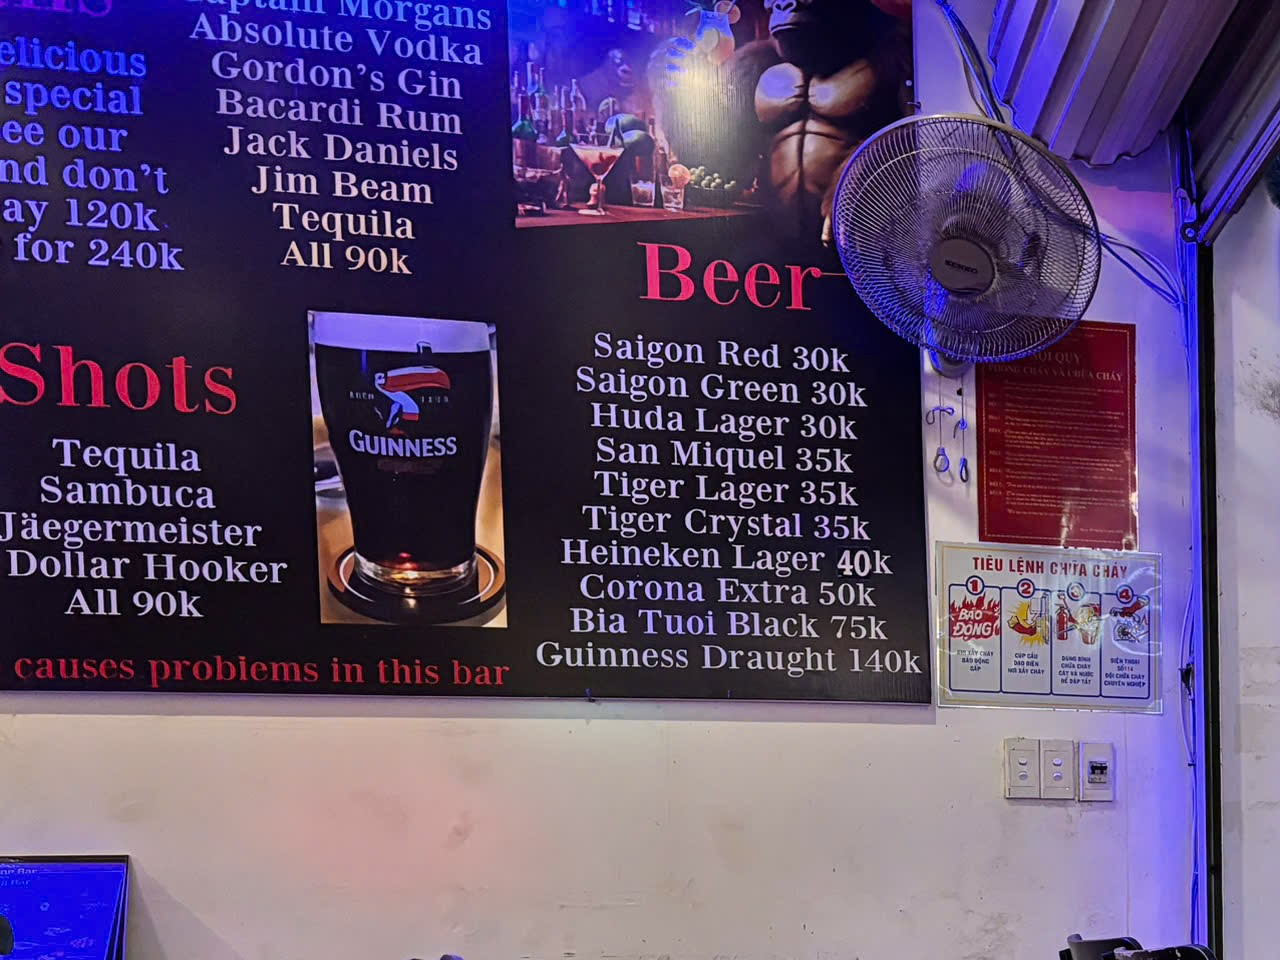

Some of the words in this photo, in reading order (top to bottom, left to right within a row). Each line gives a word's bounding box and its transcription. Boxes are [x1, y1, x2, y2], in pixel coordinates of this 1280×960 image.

[0, 36, 146, 78] elicious
[190, 13, 352, 52] Absolute
[365, 29, 483, 65] Vodka
[5, 81, 143, 116] special
[398, 69, 462, 99] Gin
[216, 88, 363, 125] Bacardi
[377, 103, 462, 134] Rum
[58, 127, 128, 151] our
[224, 126, 311, 158] Jack
[323, 134, 457, 170] Daniels
[252, 166, 319, 195] Jim
[332, 171, 433, 204] Beam
[66, 199, 159, 231] 120k
[273, 203, 415, 241] Tequila
[14, 233, 74, 263] for
[88, 239, 184, 270] 240k
[281, 241, 333, 268] All
[346, 246, 412, 274] 90k
[637, 242, 846, 310] Beer
[595, 333, 705, 368] Saigon
[719, 341, 781, 368] Red
[793, 346, 850, 372] 30k
[0, 343, 236, 414] Shots
[577, 367, 689, 402] Saigon
[701, 374, 800, 403] Green
[811, 382, 867, 407] 30k
[591, 403, 685, 431] Huda
[696, 408, 789, 442] Lager
[801, 414, 857, 439] 30k
[52, 439, 201, 476] Tequila
[349, 430, 457, 457] GUINNESS
[597, 437, 660, 464] San
[670, 441, 785, 475] Miquel
[796, 448, 853, 473] 35k
[41, 476, 216, 508] Sambuca
[594, 471, 684, 505] Tiger
[696, 475, 789, 509] Lager
[800, 481, 858, 506] 35k
[0, 512, 262, 549] Jäegermeister
[582, 506, 671, 538] Tiger
[685, 509, 802, 542] Crystal
[814, 515, 870, 540] 35k
[6, 550, 130, 578] Dollar
[143, 554, 287, 583] Hooker
[561, 539, 721, 568] Heineken
[732, 545, 825, 577] Lager
[837, 550, 893, 576] 40k
[1009, 556, 1045, 576] LỆNH
[65, 589, 121, 615] All
[133, 591, 203, 617] 90k
[580, 574, 705, 601] Corona
[717, 578, 808, 604] Extra
[819, 582, 876, 606] 50k
[970, 580, 979, 592] 1
[1020, 582, 1031, 594] 2
[1119, 588, 1131, 601] 4
[570, 608, 627, 633] Bia
[638, 610, 716, 635] Tuoi
[727, 612, 820, 637] Black
[831, 616, 888, 639] 75k
[15, 659, 134, 678] causes
[332, 658, 363, 682] in
[379, 659, 440, 684] this
[453, 660, 510, 685] bar
[537, 642, 688, 668] Guinness
[702, 645, 837, 677] Draught
[849, 649, 921, 673] 140k
